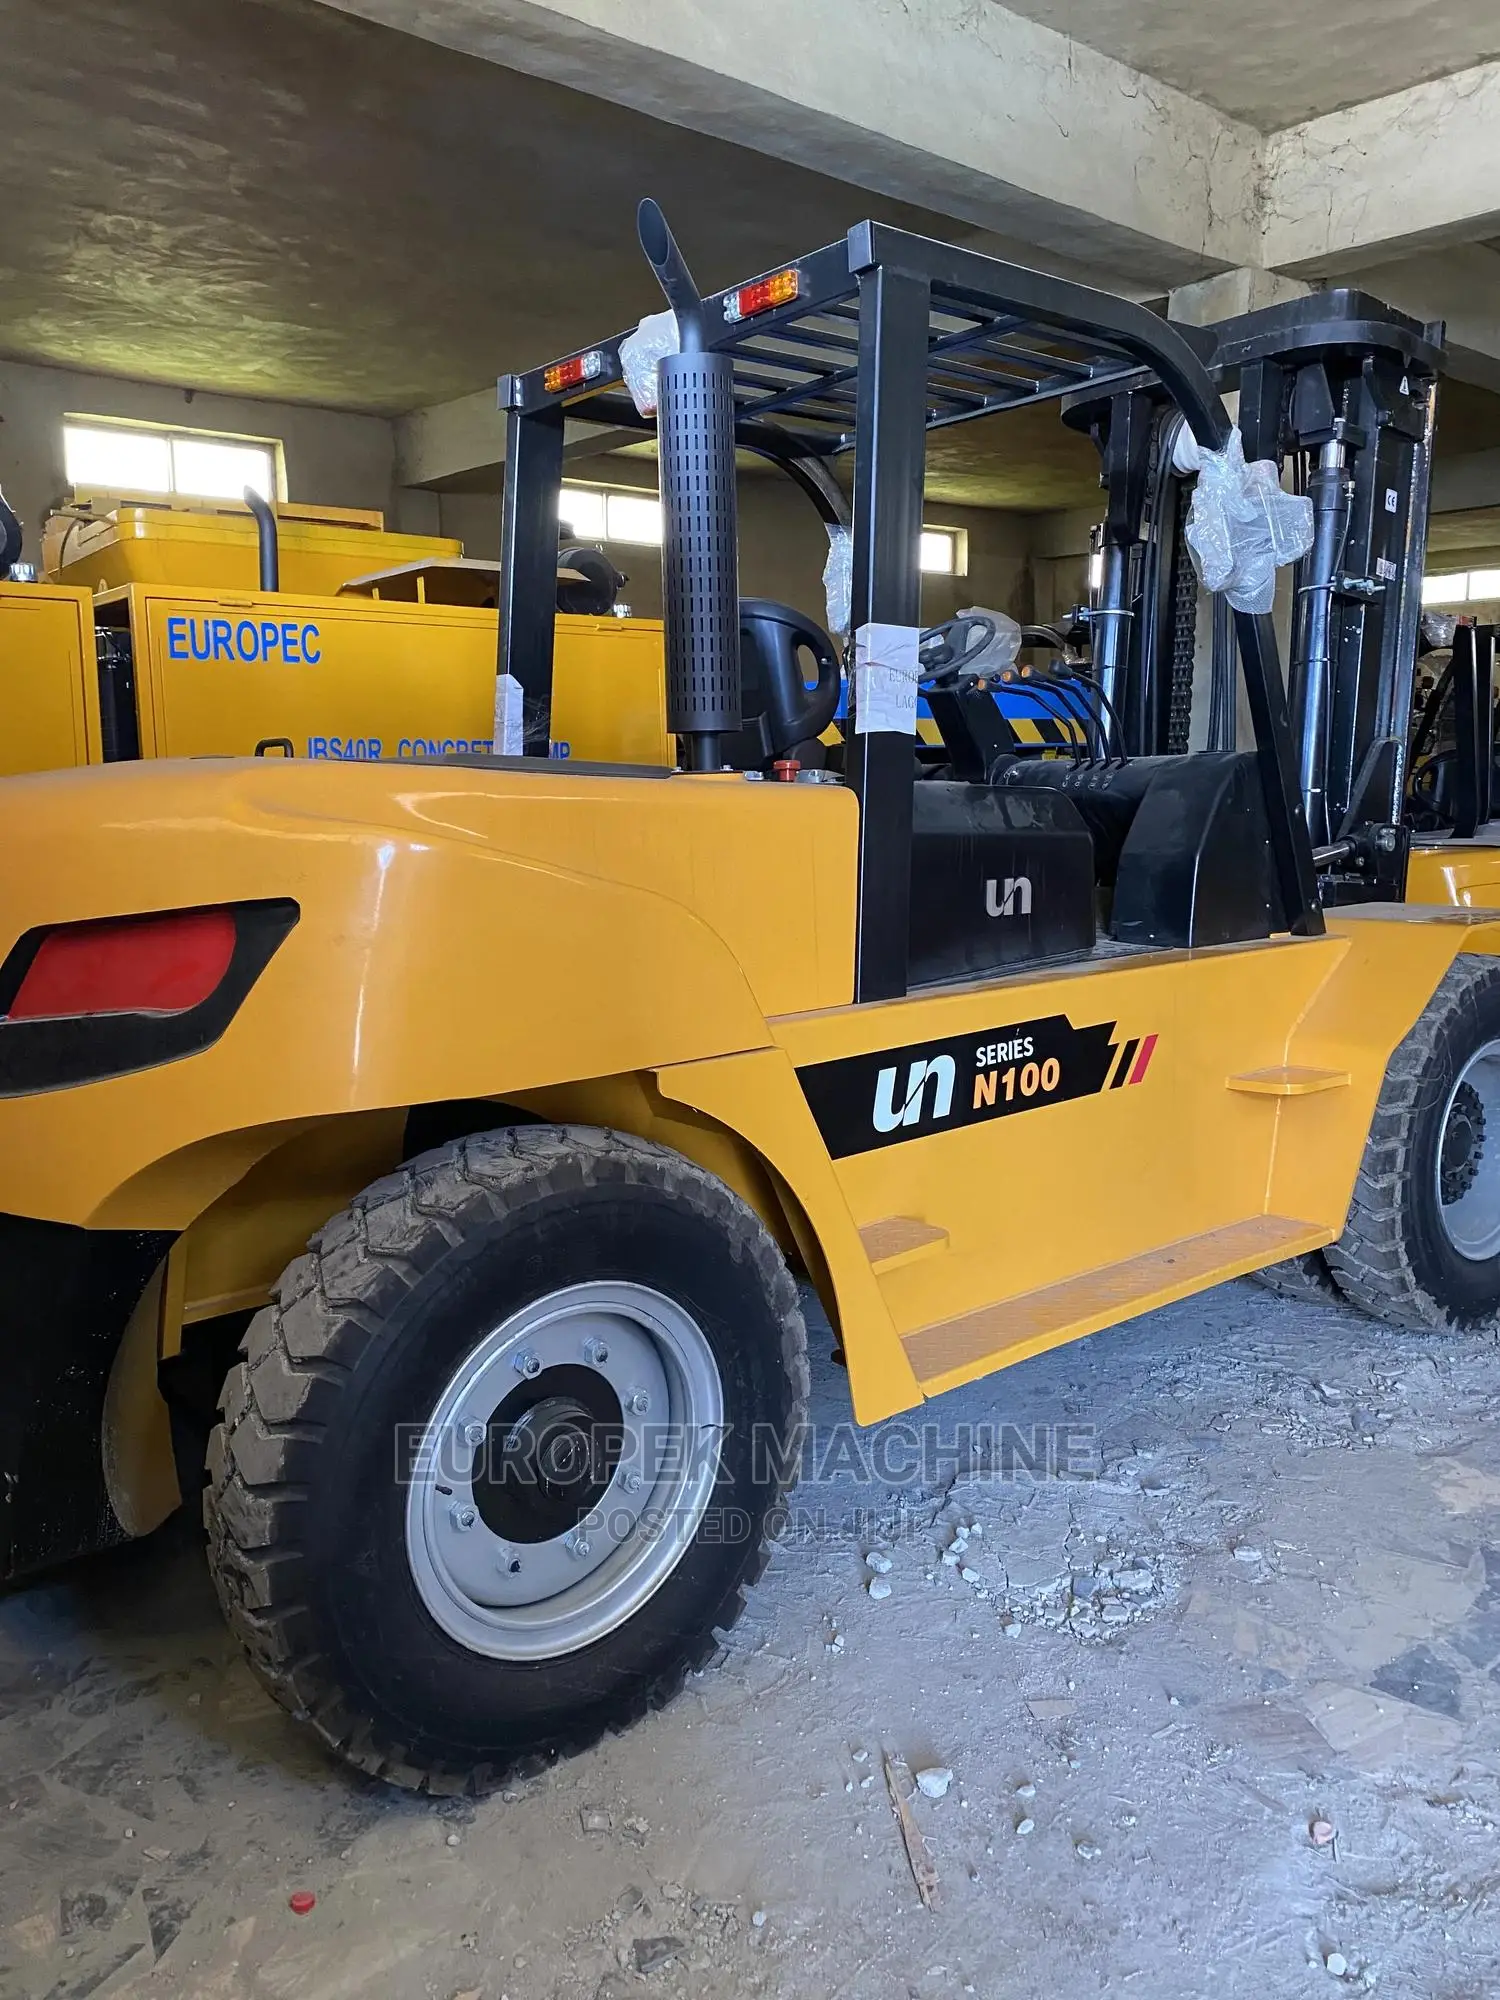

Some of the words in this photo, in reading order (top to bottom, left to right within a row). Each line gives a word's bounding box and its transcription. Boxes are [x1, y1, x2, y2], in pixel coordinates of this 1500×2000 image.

[167, 617, 321, 664] EUROPEC
[975, 1036, 1035, 1068] SERIES
[973, 1057, 1061, 1109] N100
